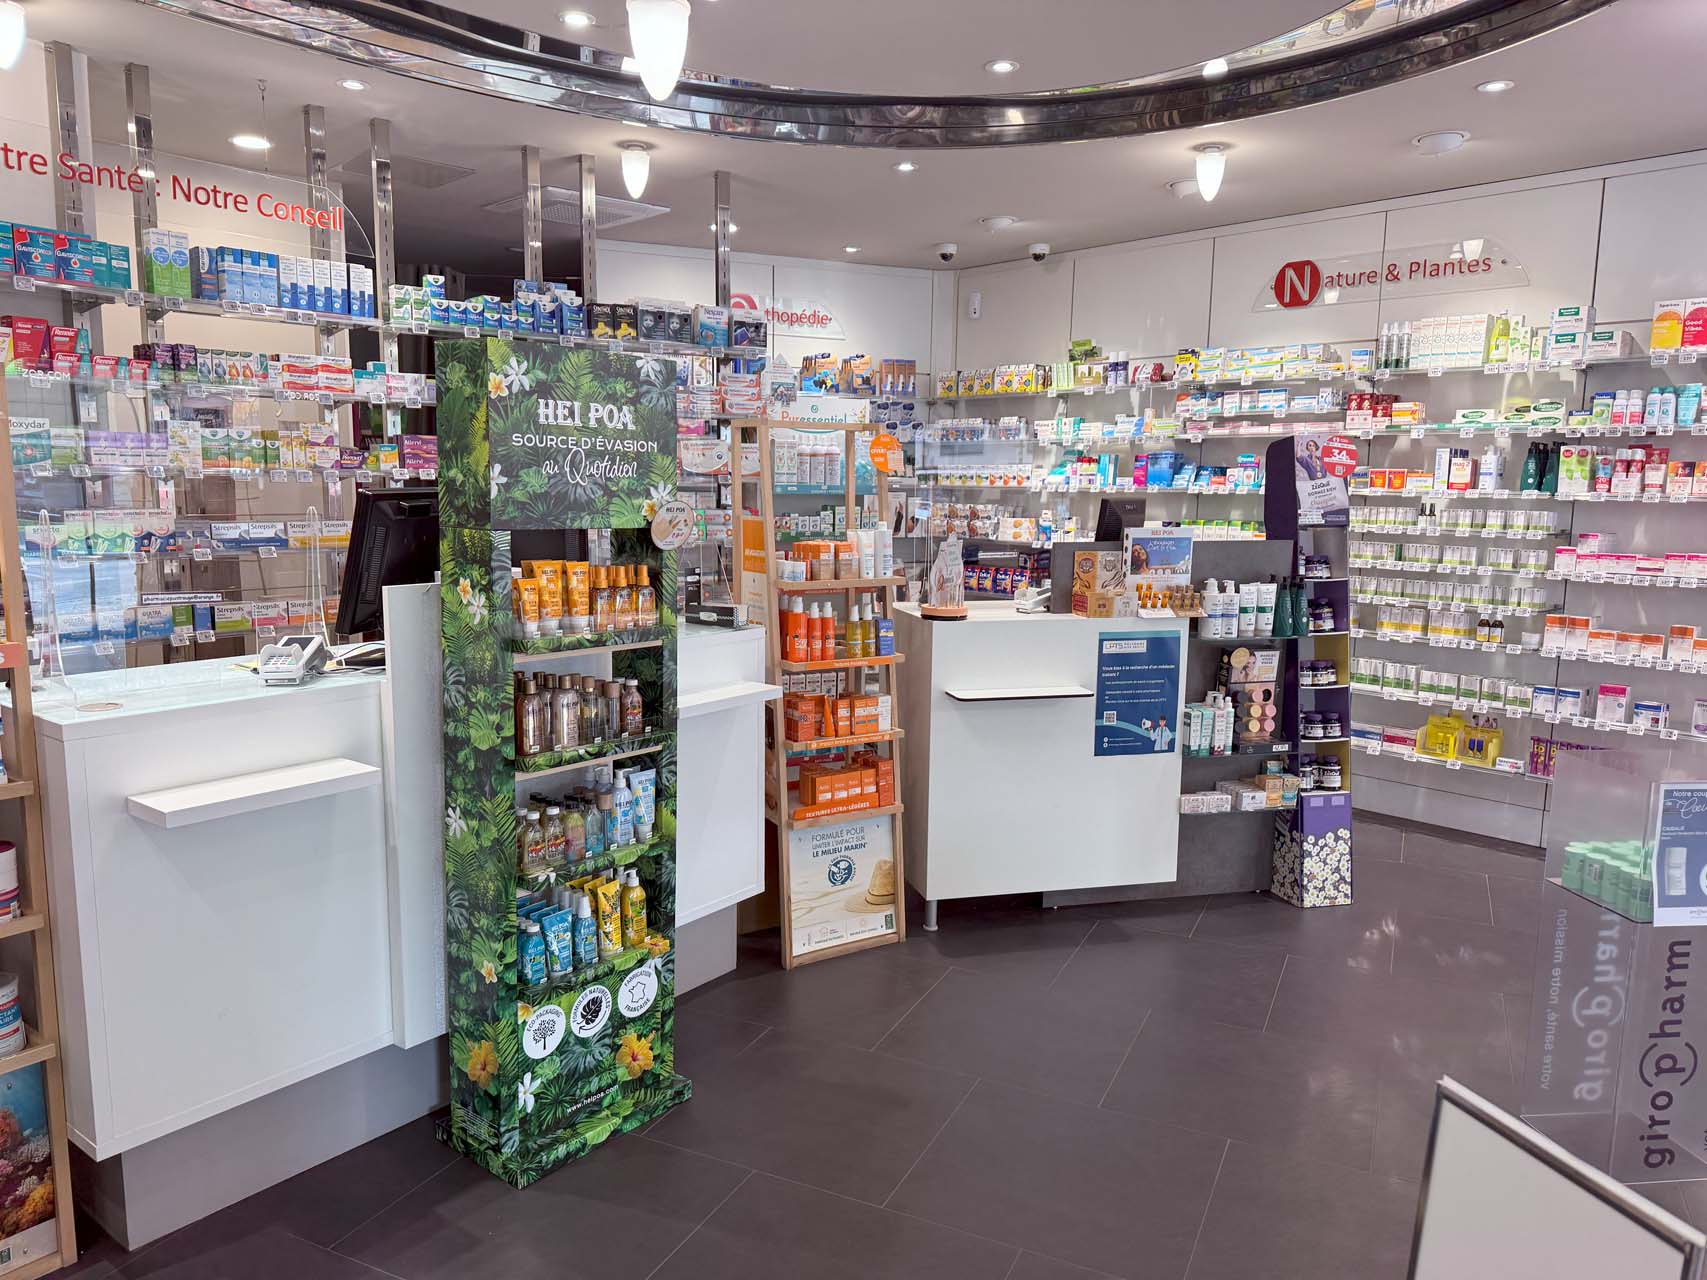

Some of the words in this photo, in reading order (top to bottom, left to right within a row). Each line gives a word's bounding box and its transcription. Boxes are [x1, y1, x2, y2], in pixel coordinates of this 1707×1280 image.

[57, 153, 144, 192] Santé
[171, 175, 249, 213] Notre
[257, 193, 344, 231] Conseil
[1283, 265, 1378, 304] Nature
[1385, 263, 1401, 283] &
[1408, 256, 1492, 280] Plantes
[538, 398, 583, 427] HEI
[588, 402, 636, 430] POA
[781, 410, 847, 424] Puressentiel
[512, 433, 577, 449] SOURCE
[581, 435, 658, 453] D'ÉVASION
[542, 459, 560, 475] au
[565, 447, 638, 486] Quotidien
[213, 523, 242, 532] Strepsils
[250, 522, 278, 531] Strepsils
[217, 605, 244, 614] Strepsils
[253, 603, 280, 612] Strepsils
[805, 808, 831, 818] TEXTURES
[846, 826, 864, 836] POUR
[812, 850, 820, 858] LE
[821, 846, 842, 857] MILIEU
